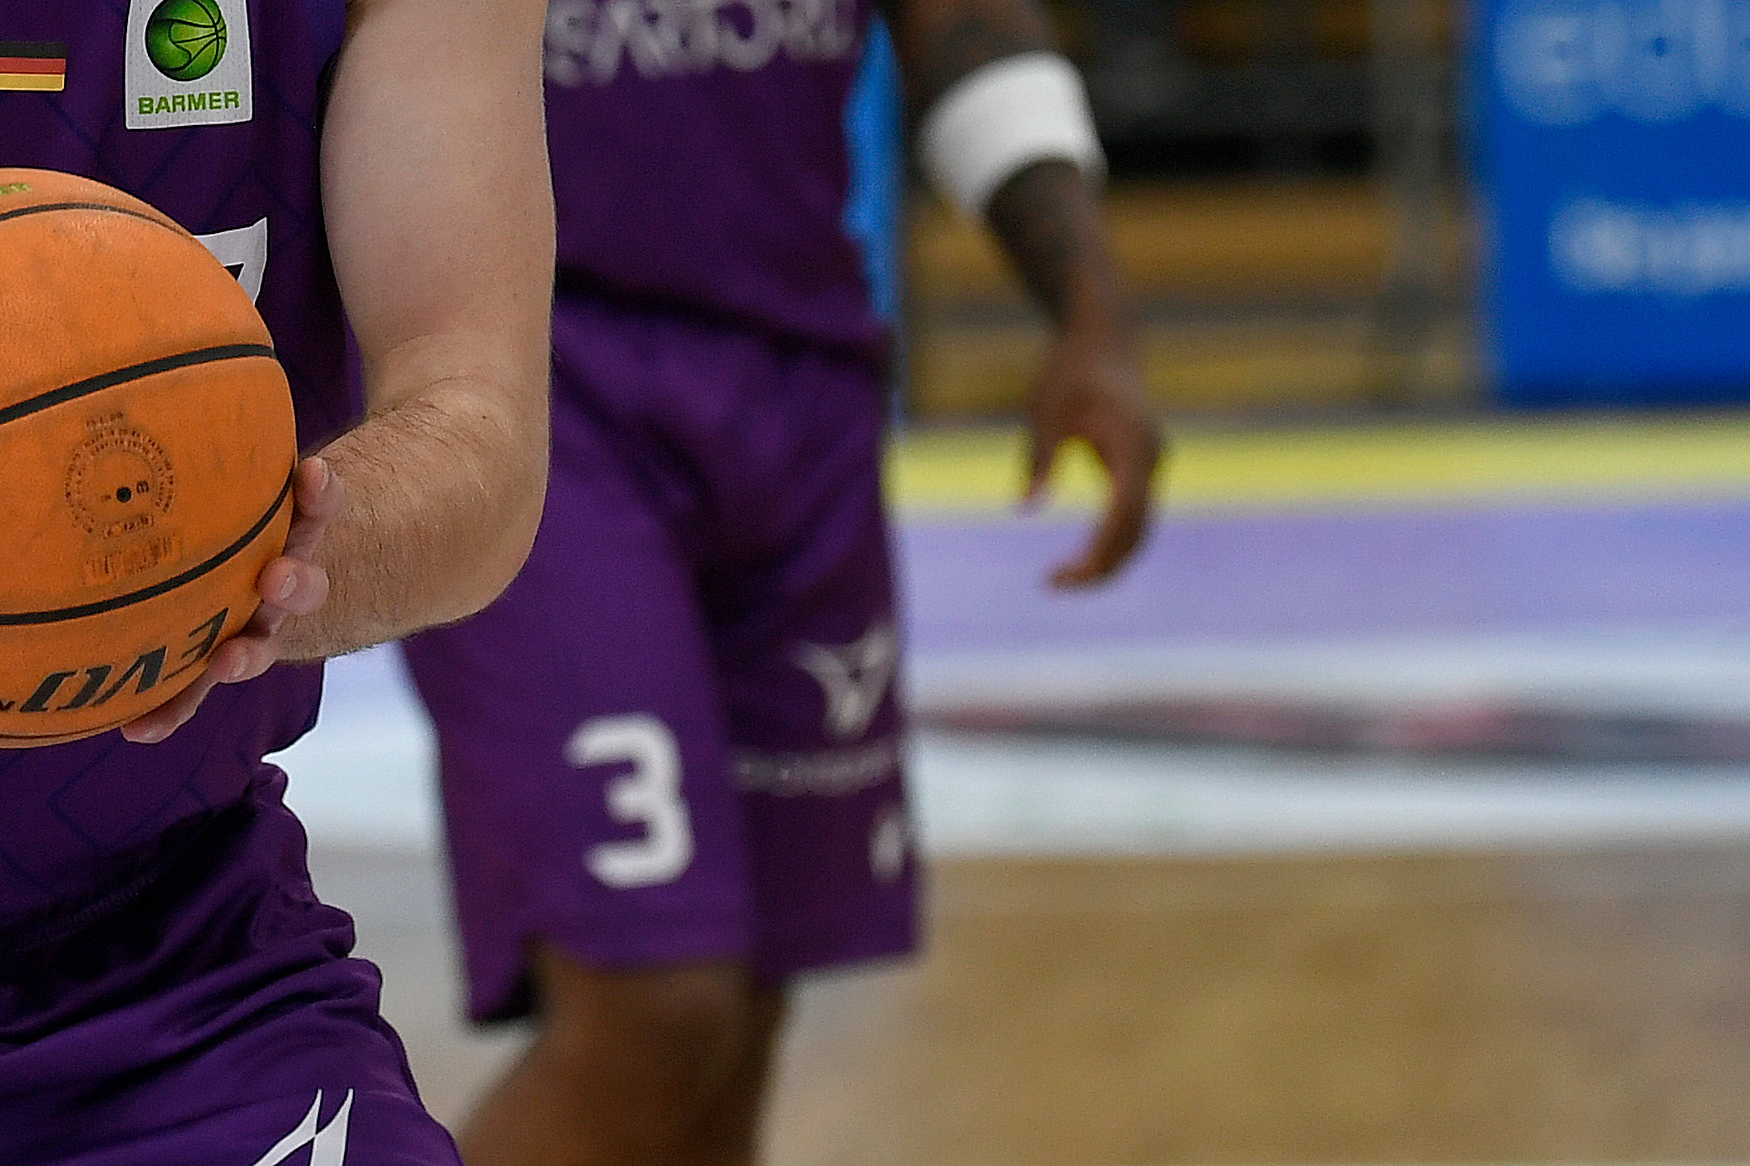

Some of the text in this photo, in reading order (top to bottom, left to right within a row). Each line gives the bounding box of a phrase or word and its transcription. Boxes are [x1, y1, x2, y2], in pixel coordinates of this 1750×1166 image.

[138, 90, 240, 115] BARMER
[19, 607, 229, 713] EVO
[565, 713, 696, 888] 3
